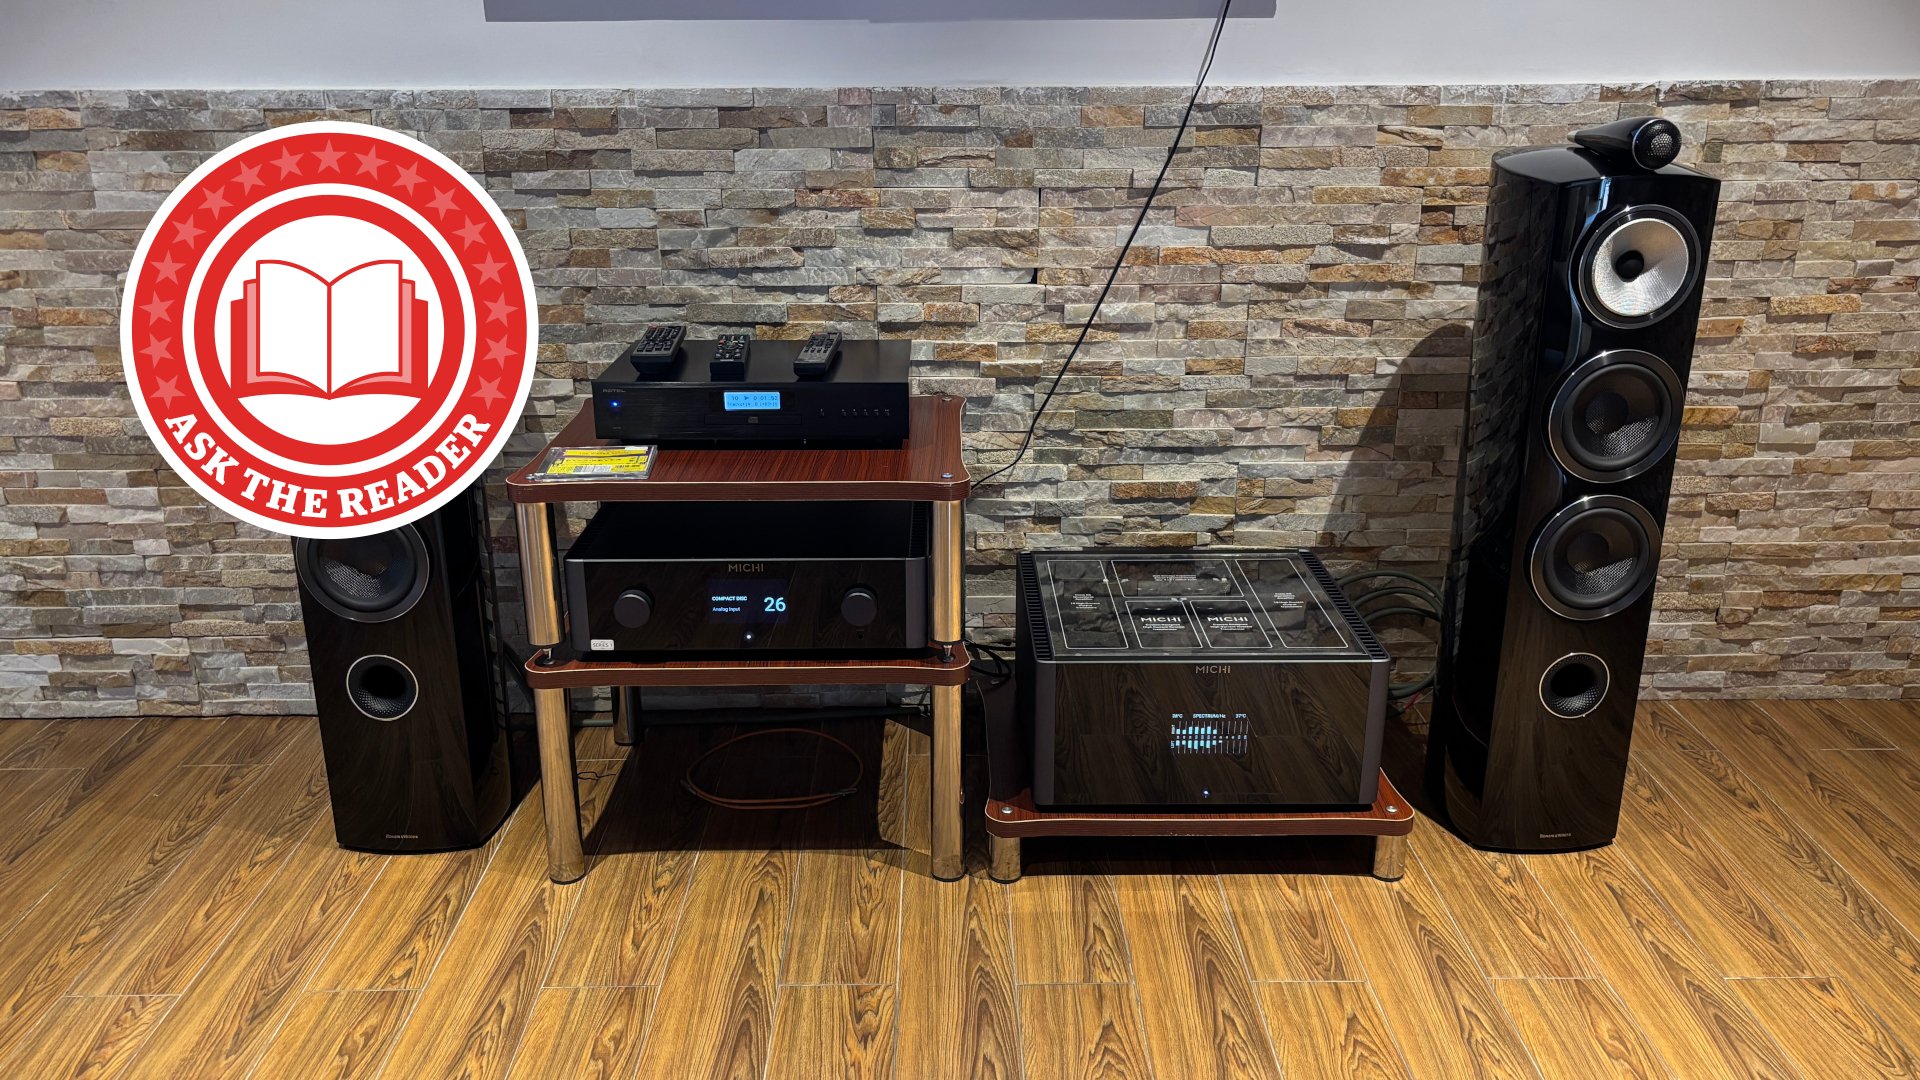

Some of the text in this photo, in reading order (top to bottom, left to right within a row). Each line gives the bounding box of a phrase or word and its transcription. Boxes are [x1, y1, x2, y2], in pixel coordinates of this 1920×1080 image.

[728, 563, 764, 573] MICHI
[764, 597, 787, 612] 26
[1195, 665, 1231, 674] MICHI
